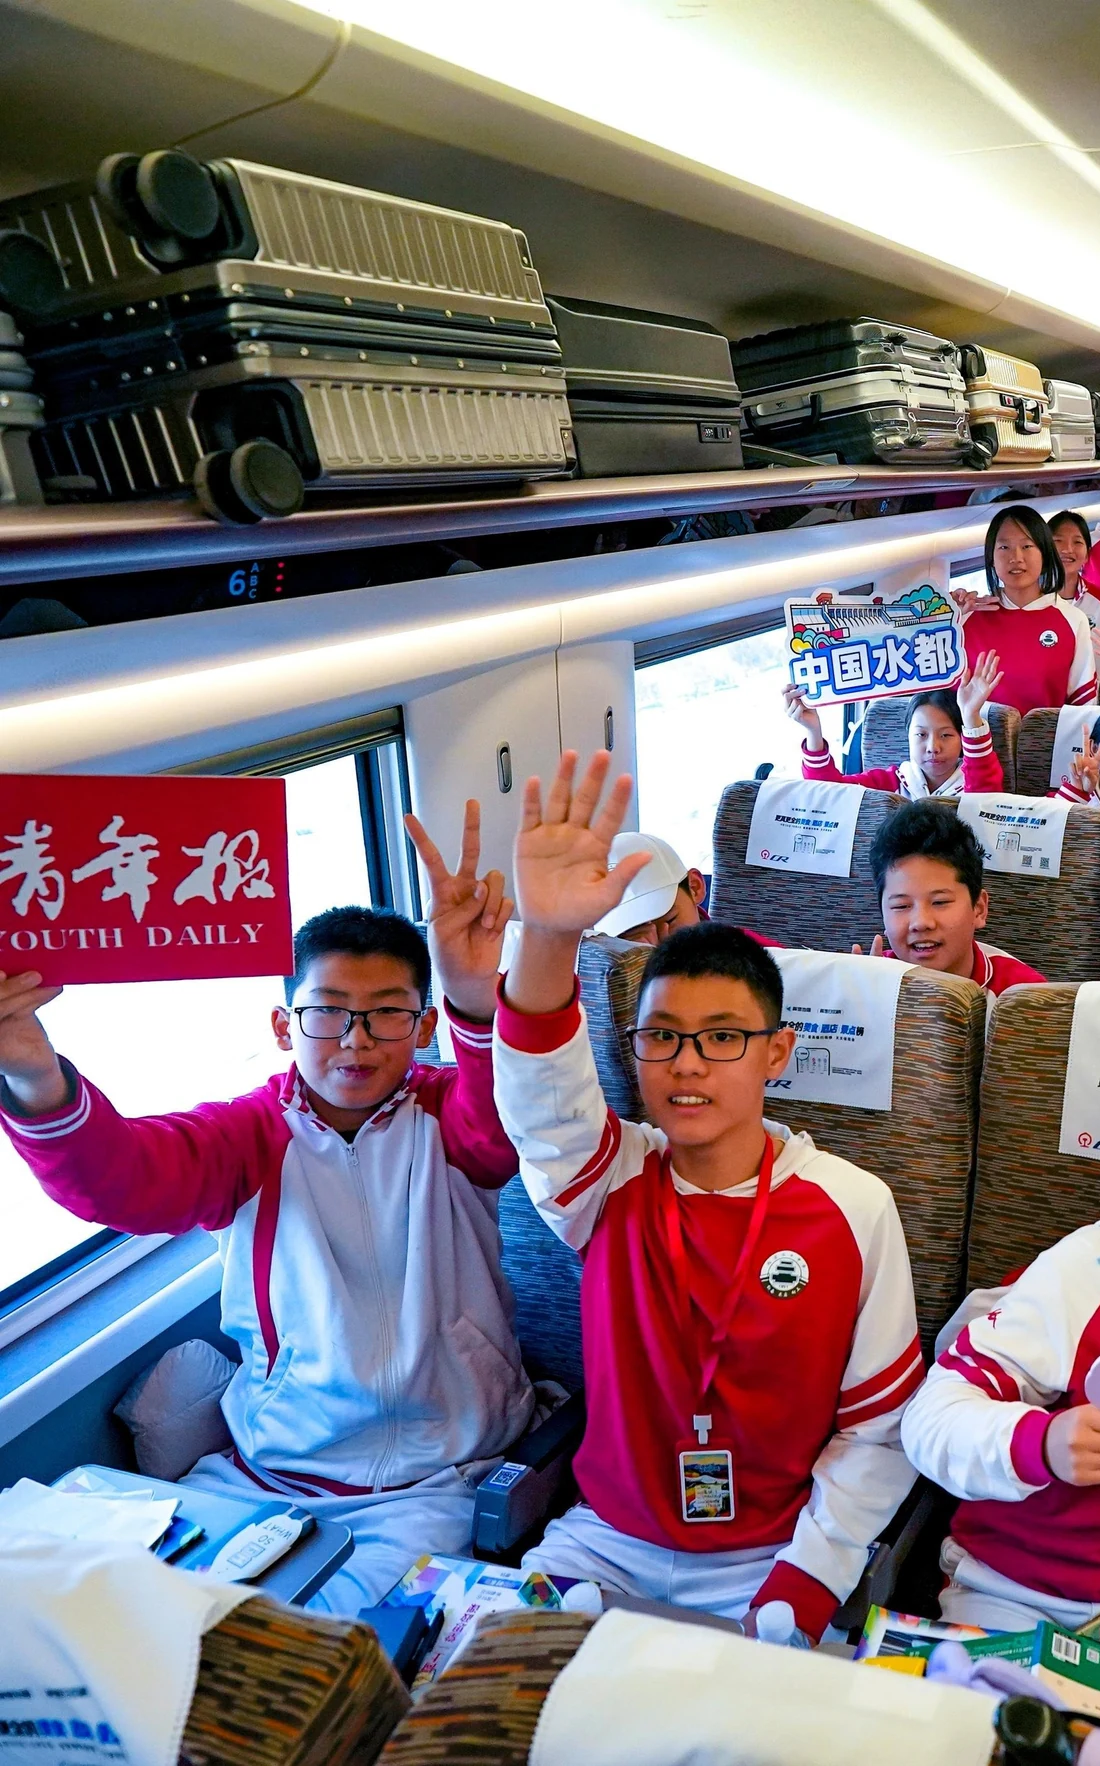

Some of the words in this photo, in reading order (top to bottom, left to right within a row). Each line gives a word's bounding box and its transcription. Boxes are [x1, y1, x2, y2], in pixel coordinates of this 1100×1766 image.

[229, 570, 246, 595] 6
[250, 562, 260, 573] A
[250, 575, 258, 586] B
[249, 588, 257, 599] C
[793, 630, 956, 695] 中国水都
[0, 814, 275, 923] 青年报
[0, 927, 124, 951] OUTH
[146, 923, 264, 947] DAILY
[262, 1522, 293, 1540] WHAT
